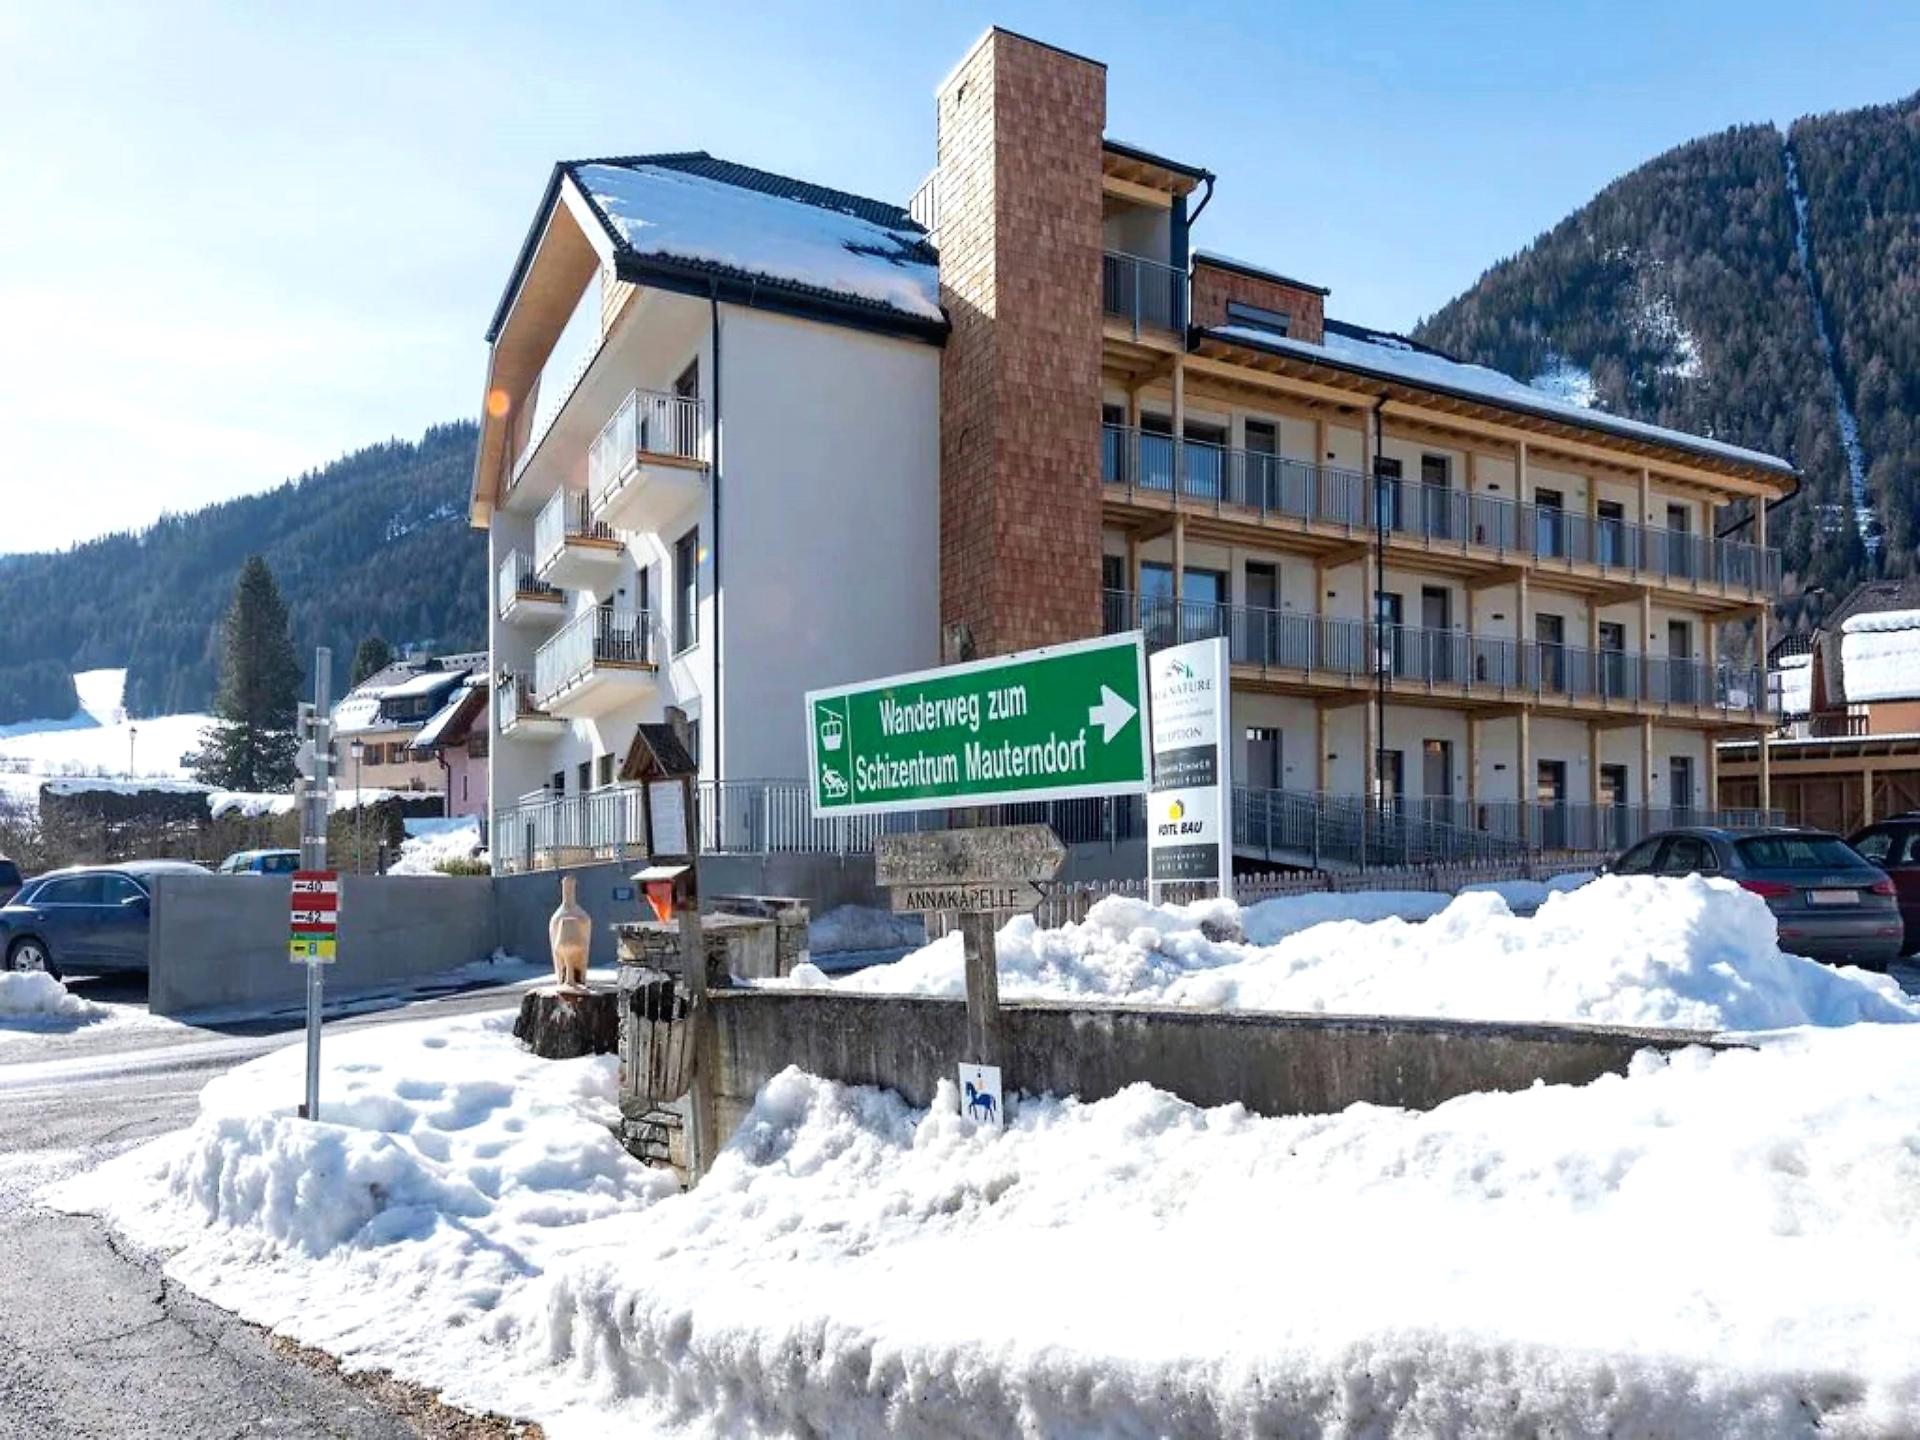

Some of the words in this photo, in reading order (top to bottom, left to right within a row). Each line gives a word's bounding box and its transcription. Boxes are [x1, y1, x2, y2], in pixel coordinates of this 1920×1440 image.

[879, 693, 981, 736] Wanderweg
[987, 685, 1028, 720] zum
[855, 750, 959, 793] Schizentrum
[964, 728, 1087, 781] Mauterndorf
[1181, 820, 1203, 834] BAU
[307, 881, 323, 892] 40
[906, 889, 1019, 910] ANNAKAPELLE
[306, 911, 321, 923] 42
